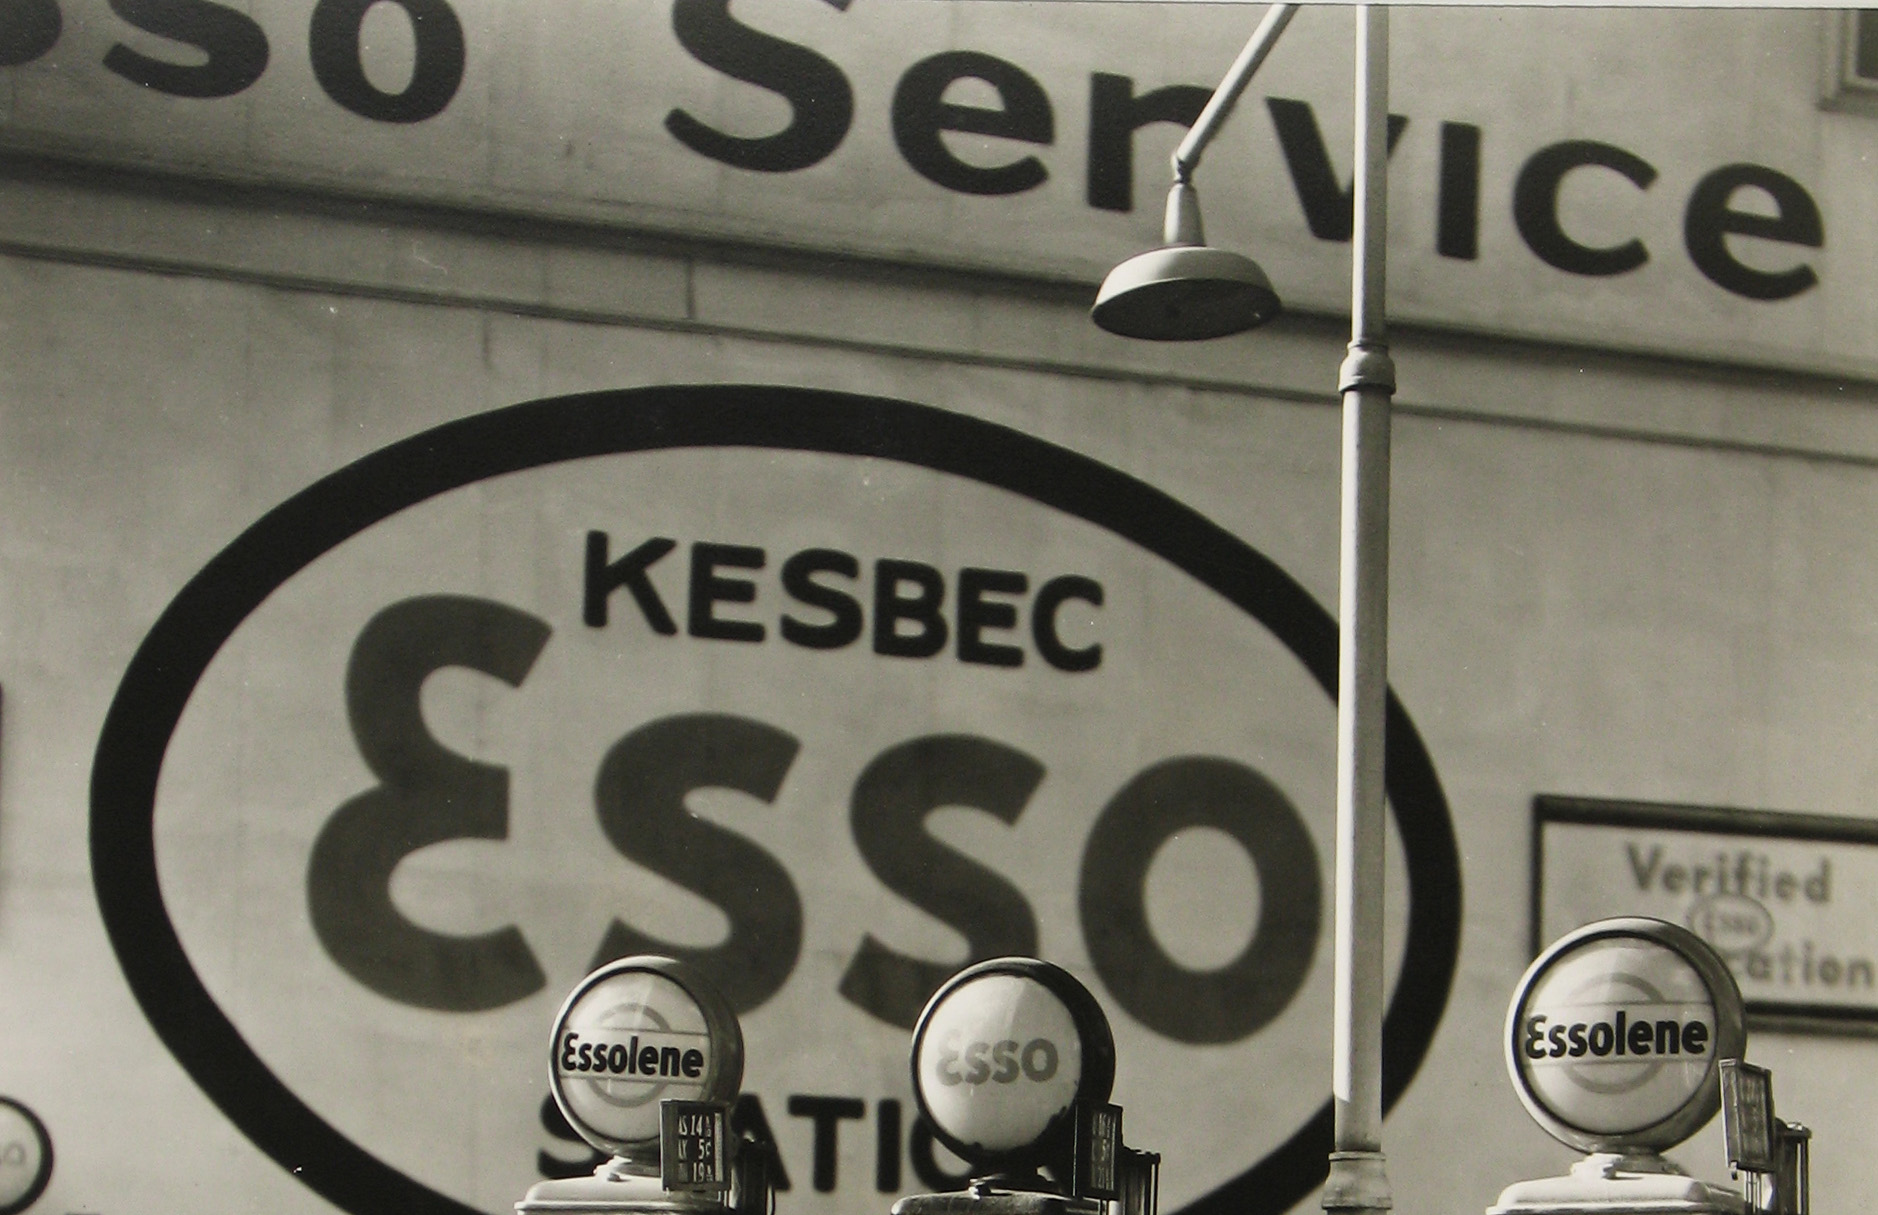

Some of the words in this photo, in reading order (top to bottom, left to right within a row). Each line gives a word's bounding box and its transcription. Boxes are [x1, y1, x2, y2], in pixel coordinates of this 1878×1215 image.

[664, 0, 1826, 301] Service
[583, 530, 1104, 674] KESBEC
[1625, 842, 1834, 906] Verified
[1746, 940, 1876, 987] ation
[561, 1032, 704, 1078] Essolene
[1525, 1011, 1709, 1059] Essolene
